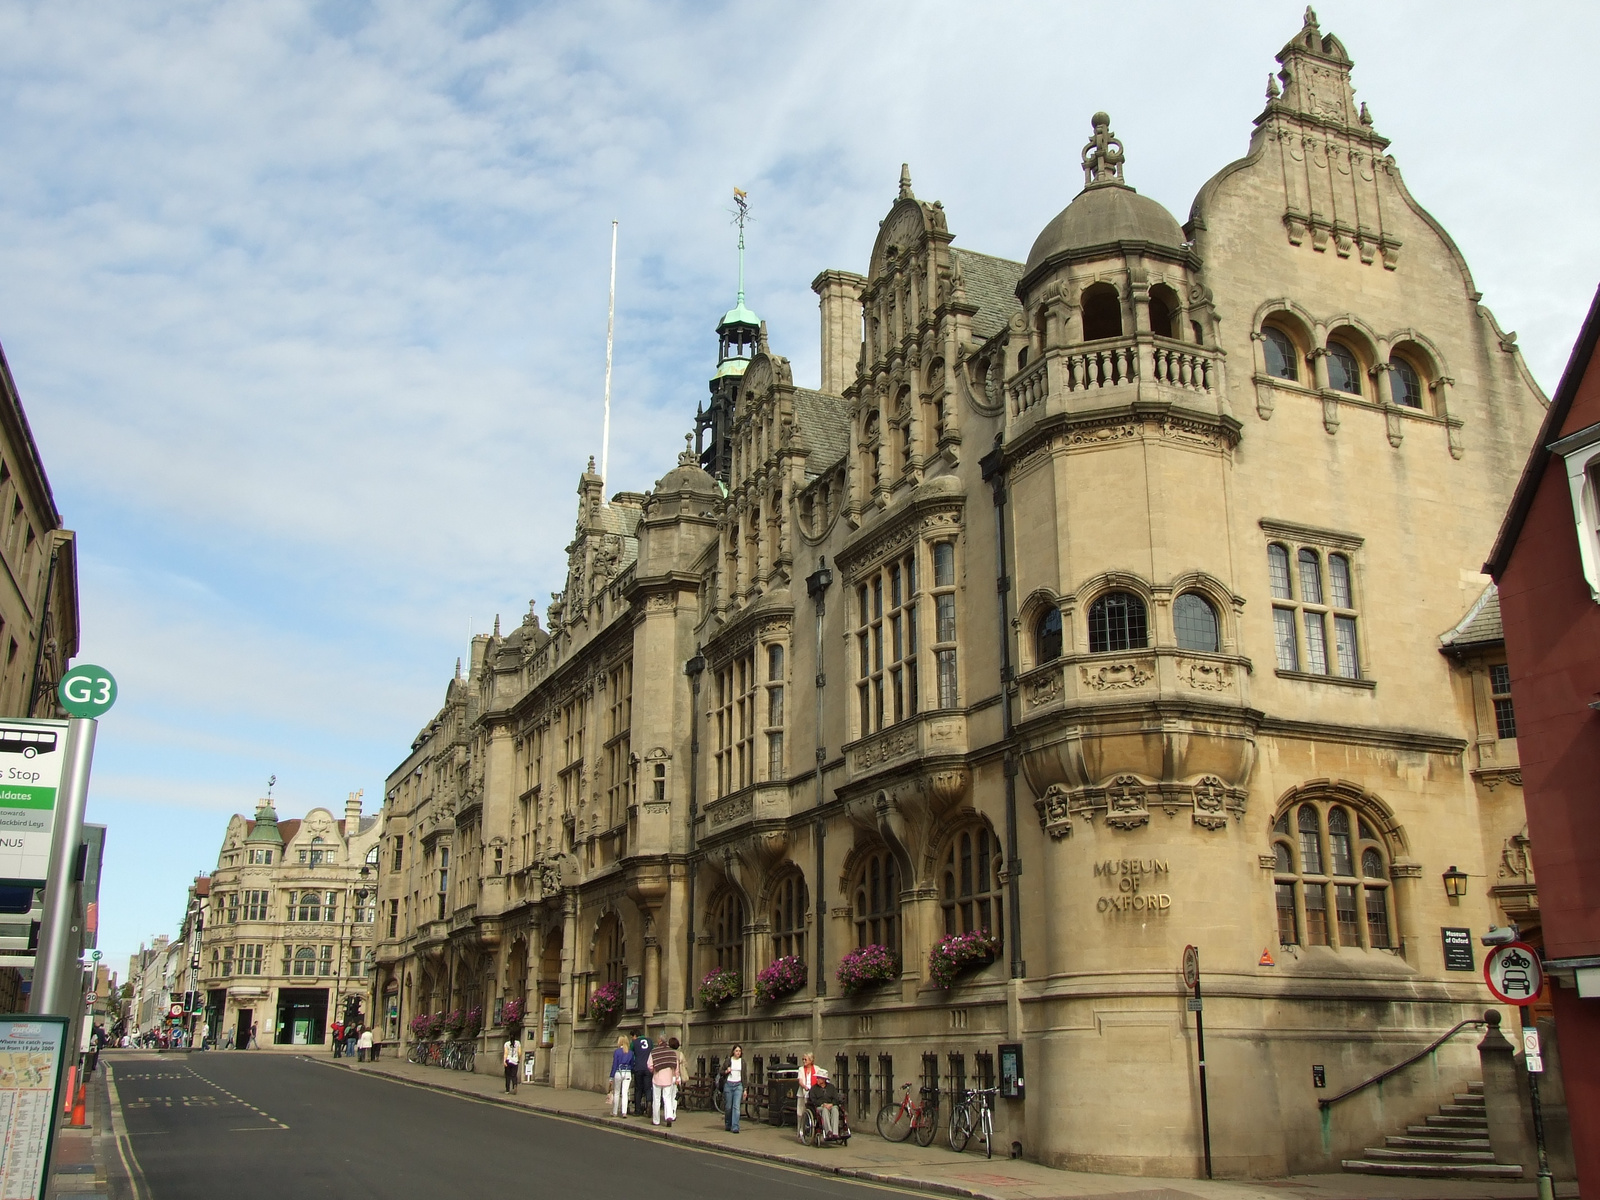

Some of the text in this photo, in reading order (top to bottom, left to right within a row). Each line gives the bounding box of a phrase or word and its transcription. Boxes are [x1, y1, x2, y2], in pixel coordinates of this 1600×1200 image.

[65, 676, 111, 704] G3
[8, 767, 40, 783] Stop
[0, 791, 32, 800] ldates
[0, 819, 44, 828] lackbird Leys
[1093, 859, 1169, 878] MUSEUM
[1119, 876, 1140, 893] OF
[1097, 894, 1172, 913] OXFORD
[640, 1039, 649, 1049] 3
